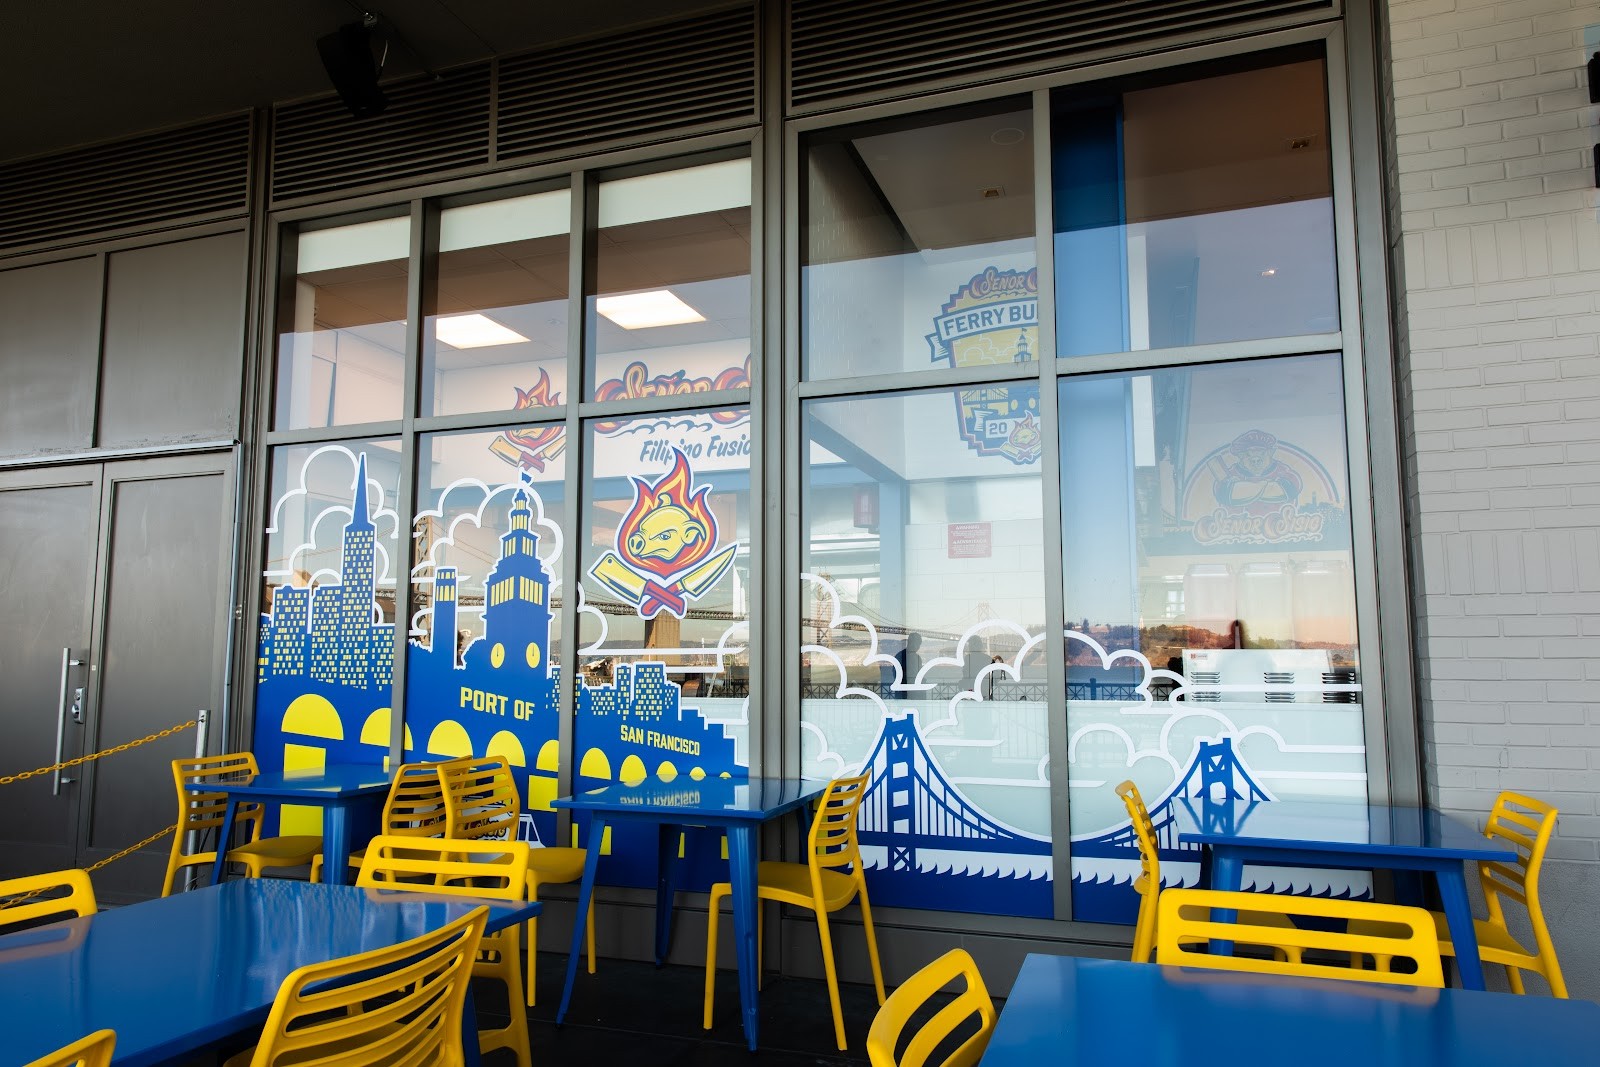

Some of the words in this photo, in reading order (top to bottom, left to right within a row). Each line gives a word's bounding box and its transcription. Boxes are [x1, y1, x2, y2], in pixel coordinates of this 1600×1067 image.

[943, 307, 1005, 336] FERRY
[1009, 303, 1038, 322] BU
[989, 421, 1008, 435] 20
[639, 438, 703, 466] Filipno
[460, 687, 509, 717] PORT
[513, 699, 535, 722] OF
[620, 724, 644, 745] SAN
[647, 728, 701, 756] FRANCISCO
